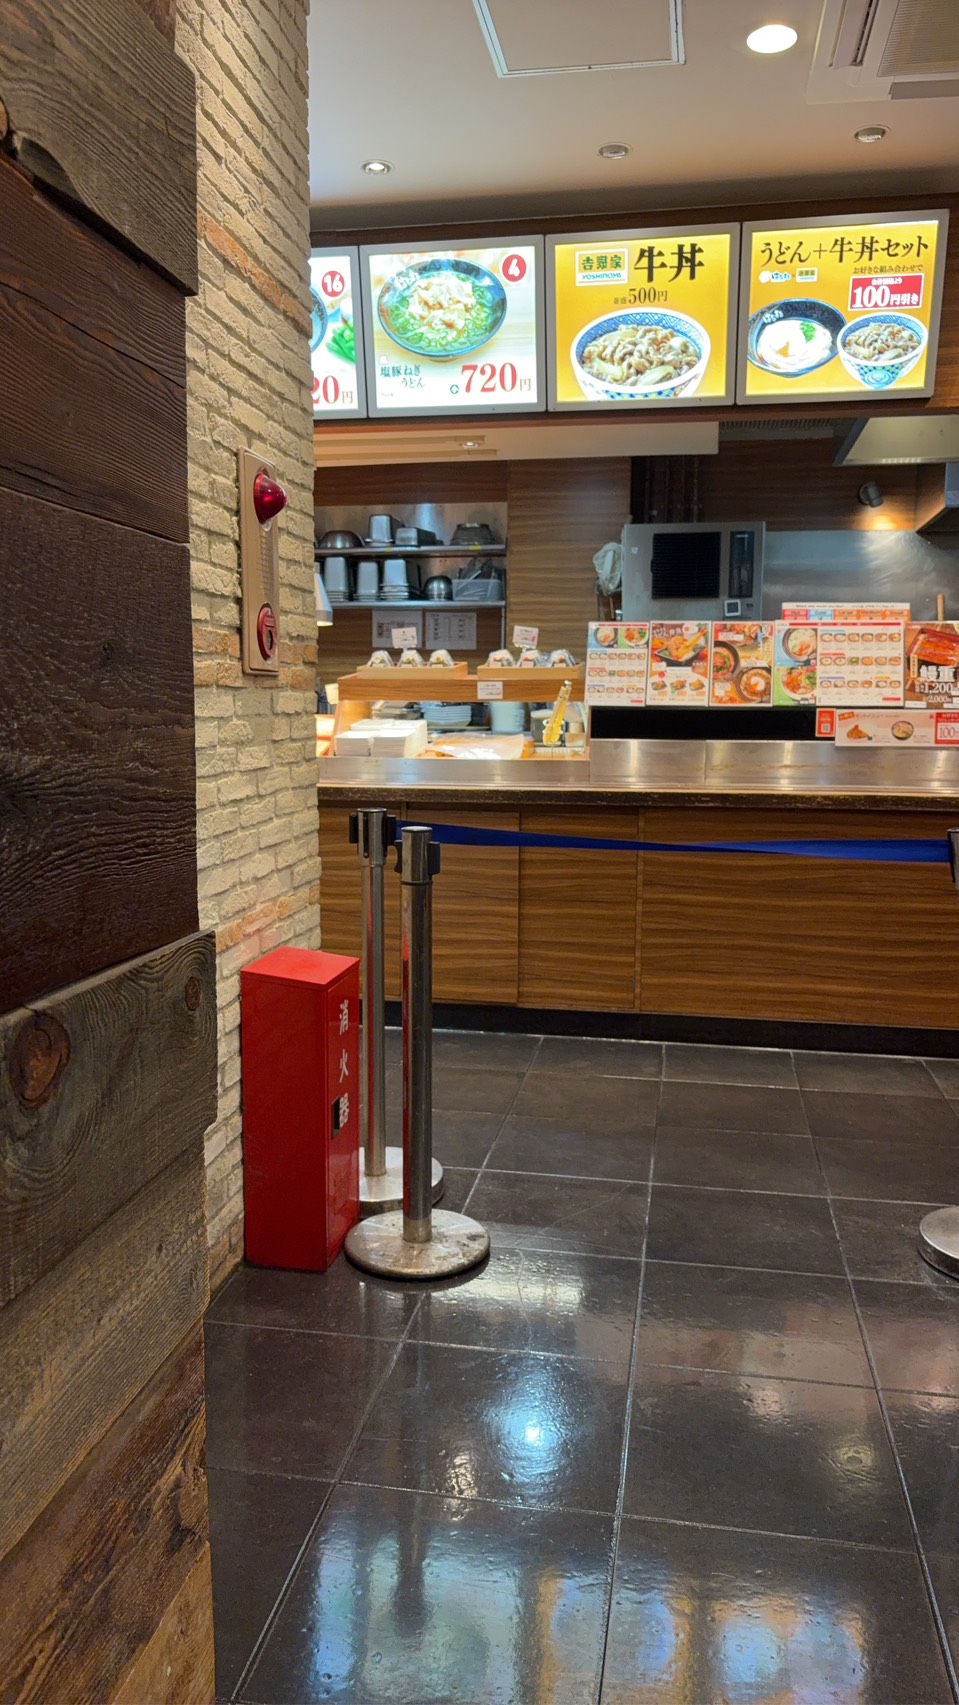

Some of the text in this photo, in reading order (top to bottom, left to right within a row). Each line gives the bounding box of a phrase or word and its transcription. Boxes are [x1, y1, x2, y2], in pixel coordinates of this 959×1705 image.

[507, 259, 521, 277] 4
[633, 243, 705, 283] 牛丼
[853, 264, 924, 275] お好きな組み合わせで
[323, 273, 344, 293] 16
[851, 285, 920, 308] 100円引き
[401, 377, 424, 389] うどん
[460, 362, 532, 393] 720円
[339, 999, 350, 1128] 消火器
